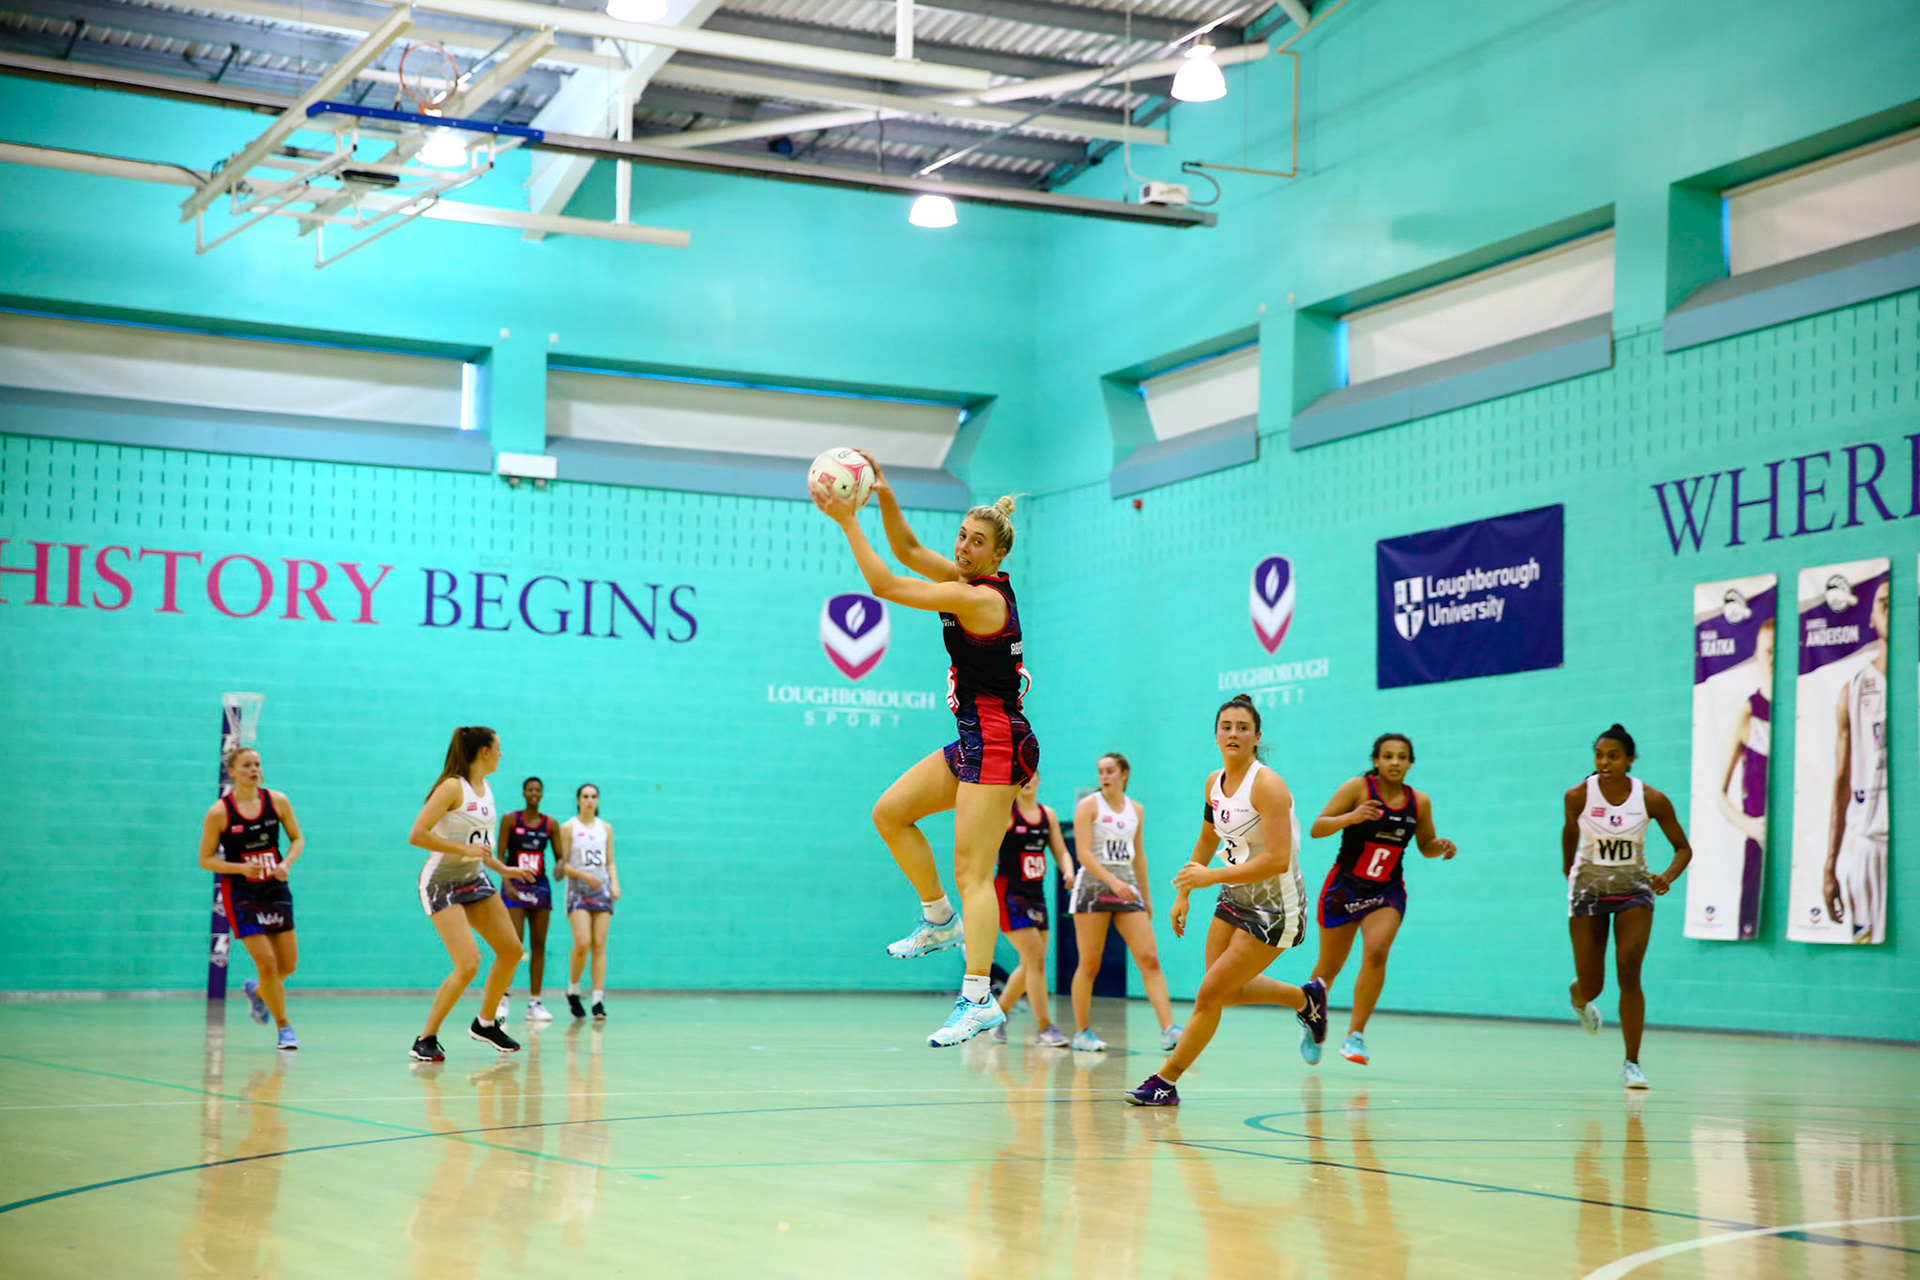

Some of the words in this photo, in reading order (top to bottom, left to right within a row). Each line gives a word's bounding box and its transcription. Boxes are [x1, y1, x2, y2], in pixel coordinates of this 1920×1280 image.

[0, 539, 394, 625] HISTORY
[418, 567, 698, 644] BEGINS
[1427, 557, 1540, 600] Loughborough
[1428, 594, 1505, 627] University
[1218, 657, 1329, 691] LOUGHBOROUGH
[767, 685, 936, 709] LOUGHBOROUGH
[804, 710, 900, 728] SPORT
[1106, 839, 1131, 861] WA
[1366, 847, 1391, 878] C
[1597, 839, 1632, 861] WD
